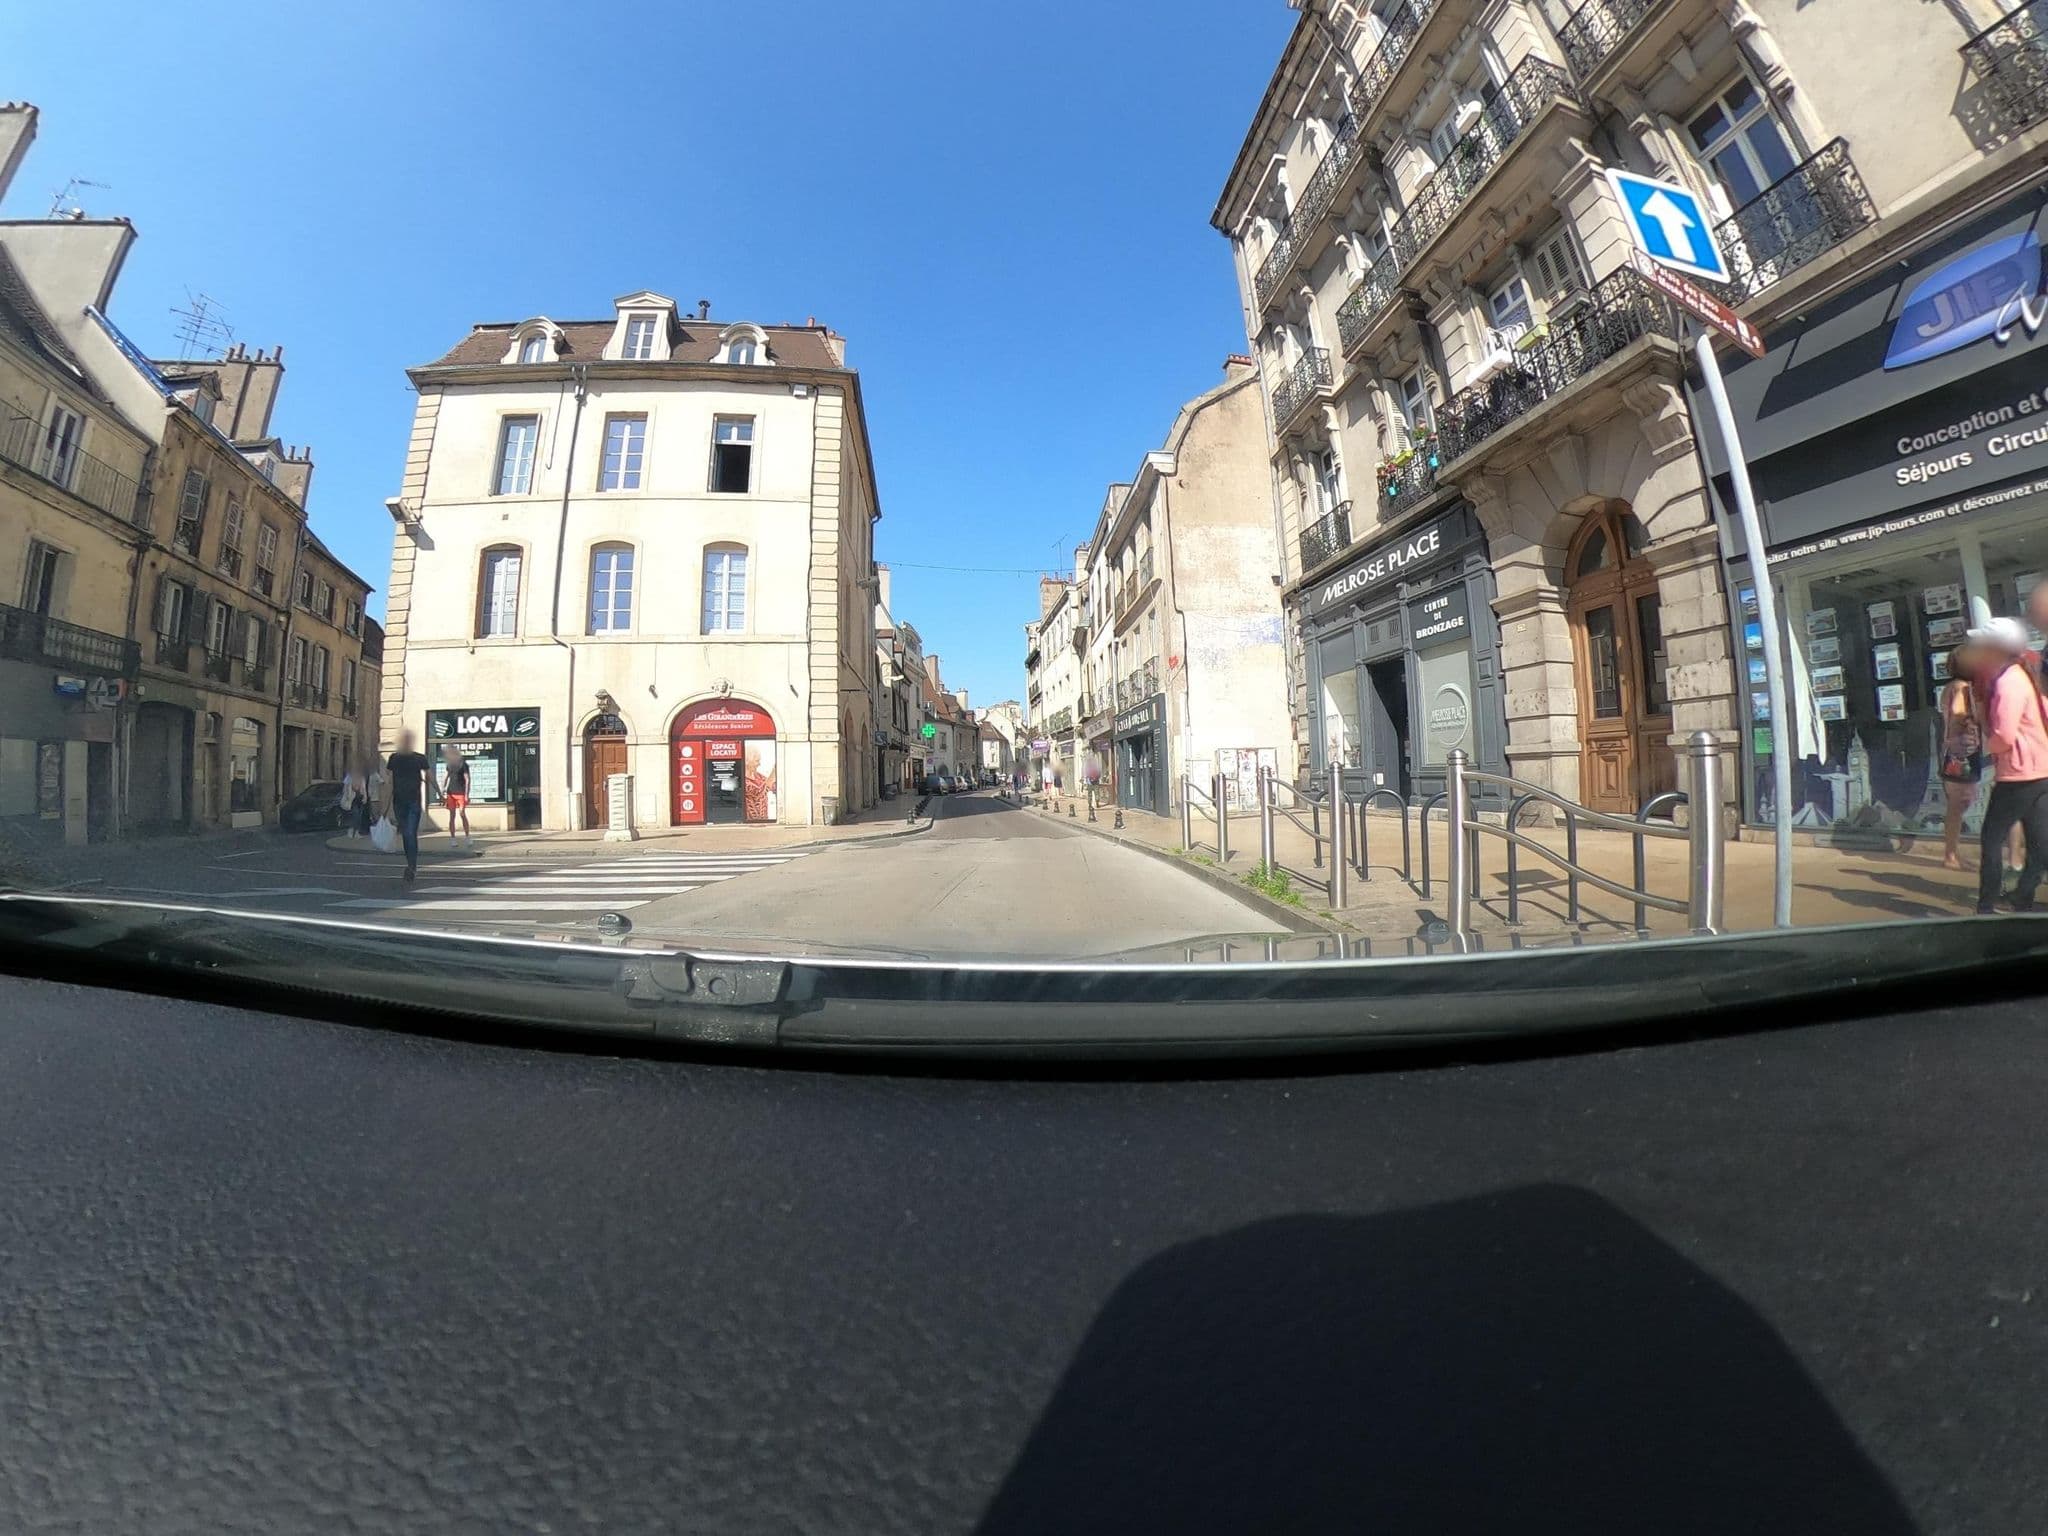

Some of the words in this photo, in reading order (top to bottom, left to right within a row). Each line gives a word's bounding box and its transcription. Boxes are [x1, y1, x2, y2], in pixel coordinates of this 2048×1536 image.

[1916, 260, 2024, 338] JIP
[1897, 405, 2015, 455] Conception
[2018, 393, 2041, 414] et
[1896, 452, 1973, 485] Séjours
[1790, 545, 1817, 558] notre
[1819, 539, 1838, 551] site
[1839, 508, 1945, 545] www.jip-tours.com
[1947, 504, 1962, 516] et
[1963, 485, 2032, 512] découvrez
[1320, 559, 1385, 605] MELROSE
[1388, 529, 1440, 571] PLACE
[1424, 597, 1449, 613] CENTRE
[1433, 612, 1442, 622] DE
[1416, 616, 1465, 639] BRONZAGE
[457, 715, 508, 733] LOC'A
